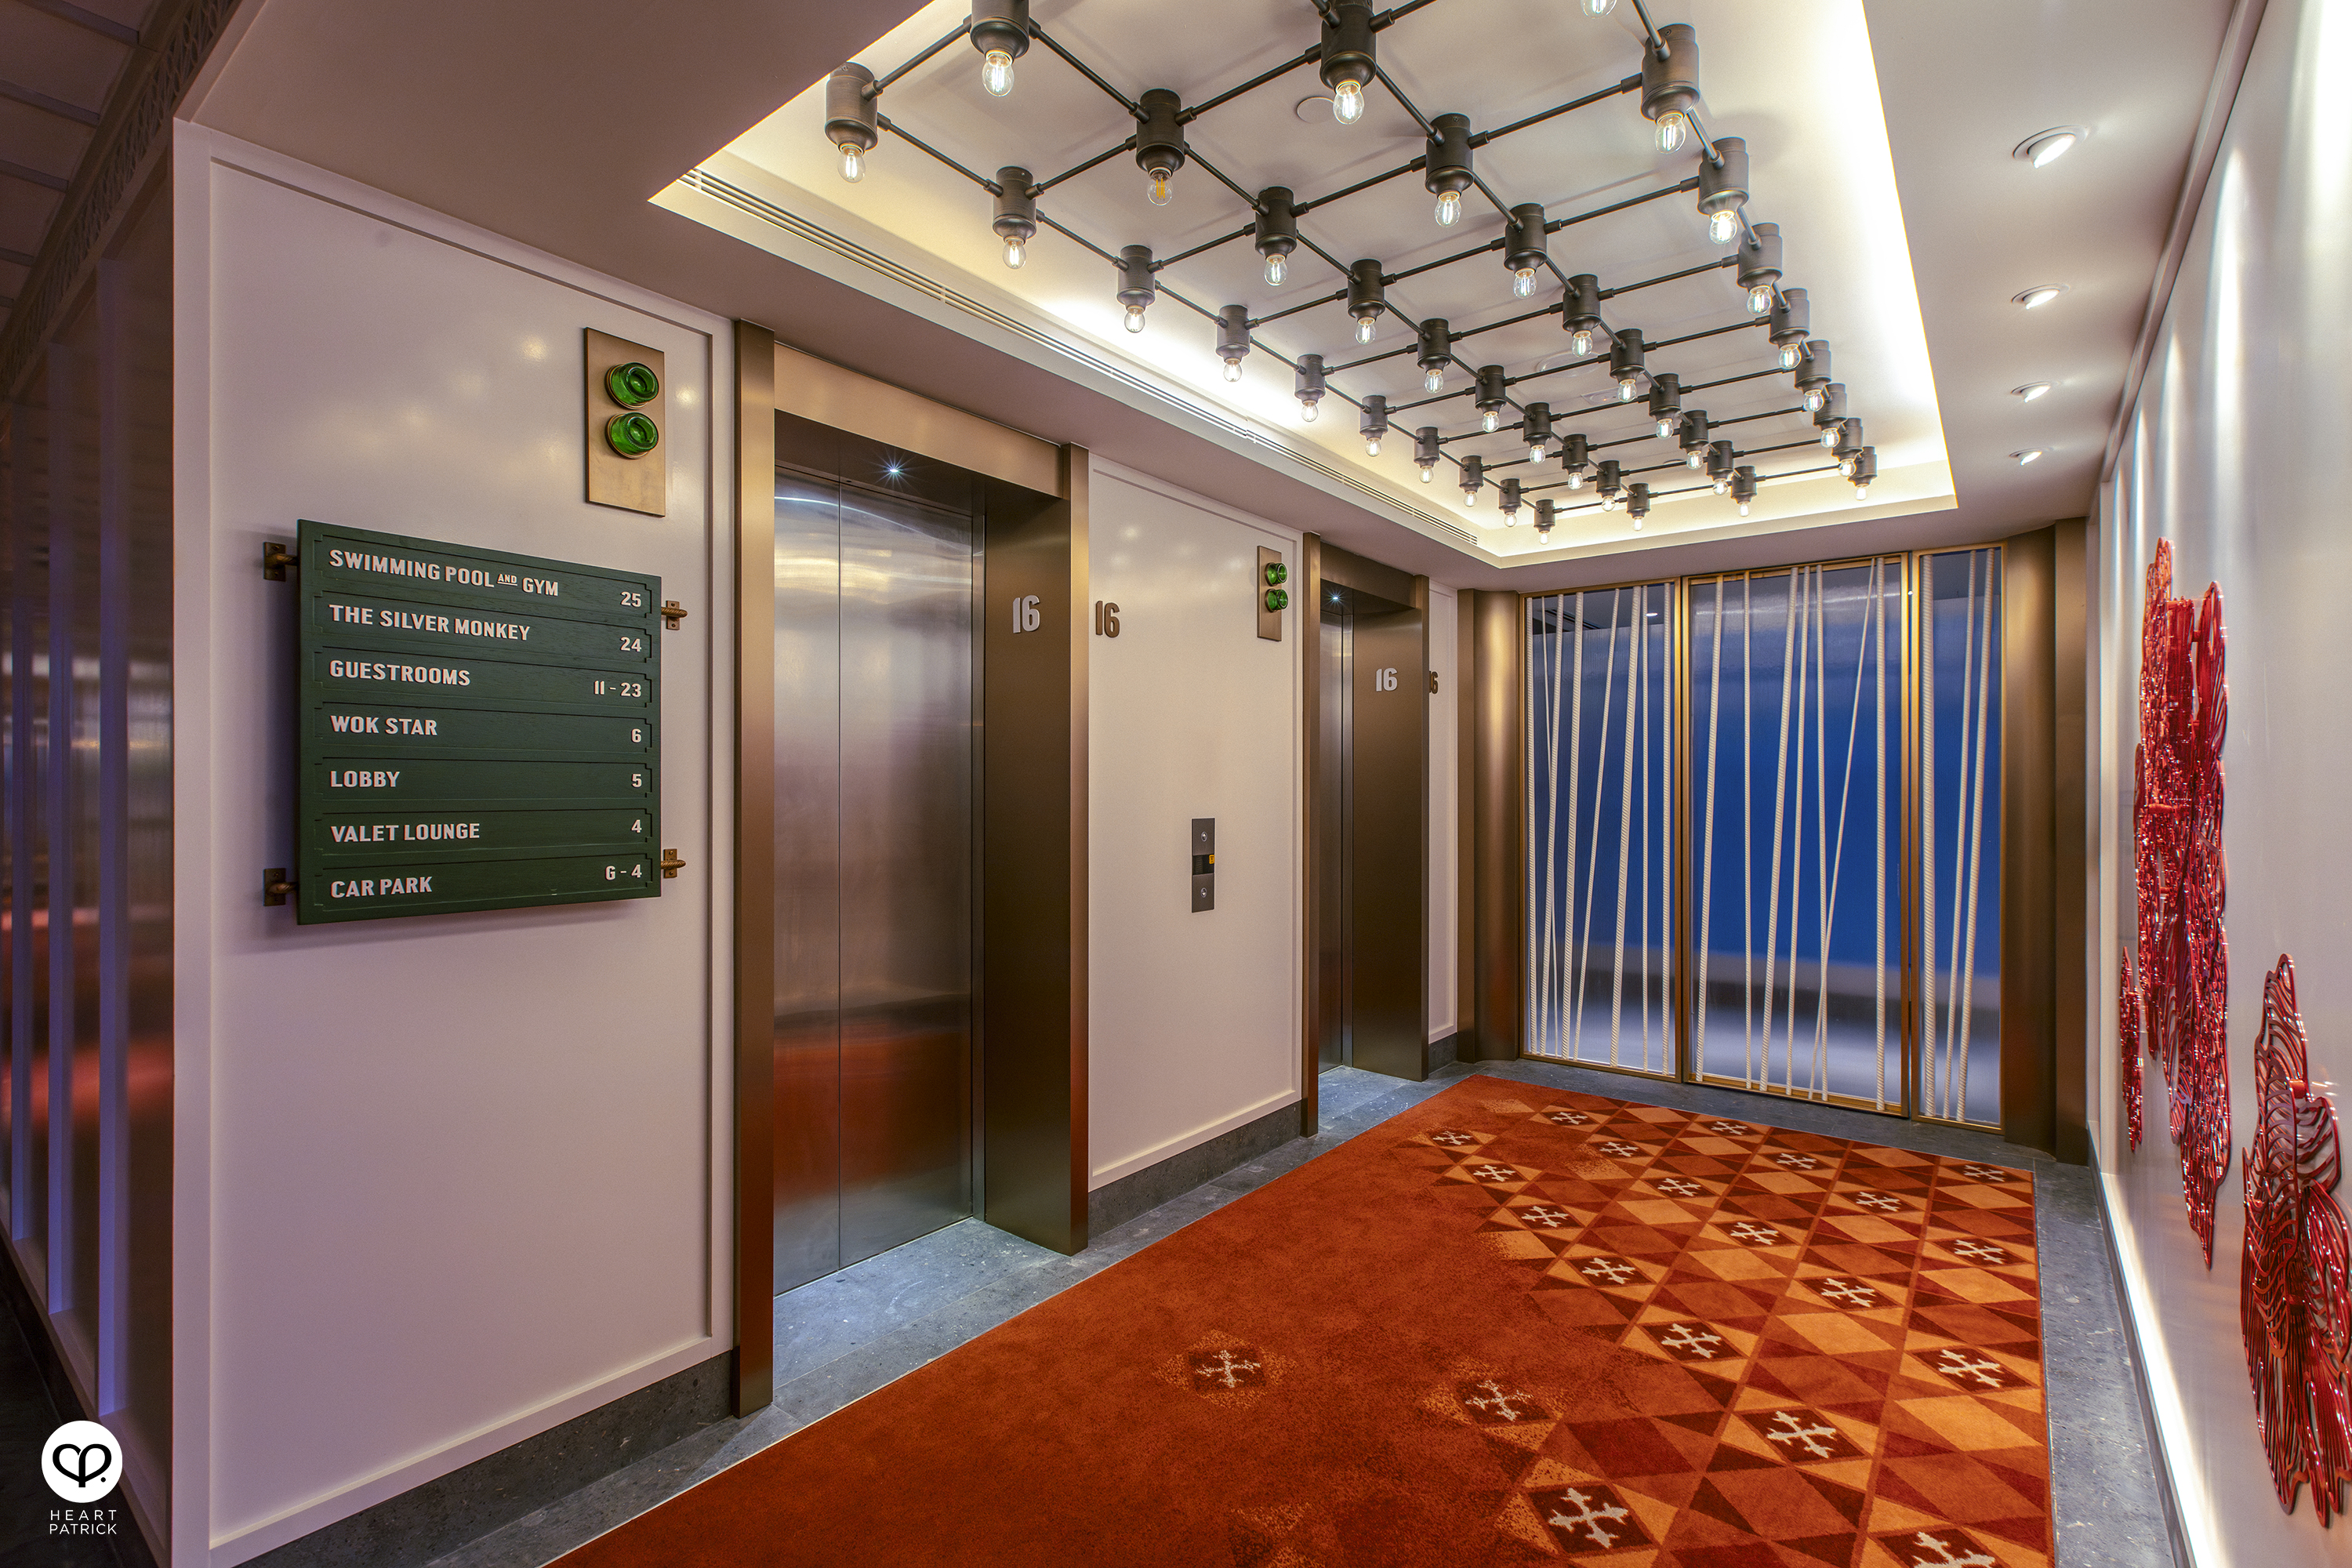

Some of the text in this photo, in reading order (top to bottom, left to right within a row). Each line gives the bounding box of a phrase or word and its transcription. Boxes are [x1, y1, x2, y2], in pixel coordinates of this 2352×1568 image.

[330, 550, 641, 608] SWIMMING POOL AND GYM 25
[329, 604, 642, 652] THE SILVER MONKEY 24
[1012, 594, 1040, 633] 16
[1095, 600, 1120, 638] 16
[330, 660, 470, 686] GUESTROOMS
[594, 680, 605, 695] 11
[621, 682, 641, 698] 23
[1376, 667, 1398, 691] 16
[331, 715, 642, 743] WOK STAR 6
[331, 770, 642, 788] LOBBY 5
[331, 819, 642, 843] VALET LOUNGE 4
[332, 880, 375, 898] CAR
[380, 876, 433, 895] PARK
[605, 866, 616, 880] G
[631, 864, 643, 878] 4
